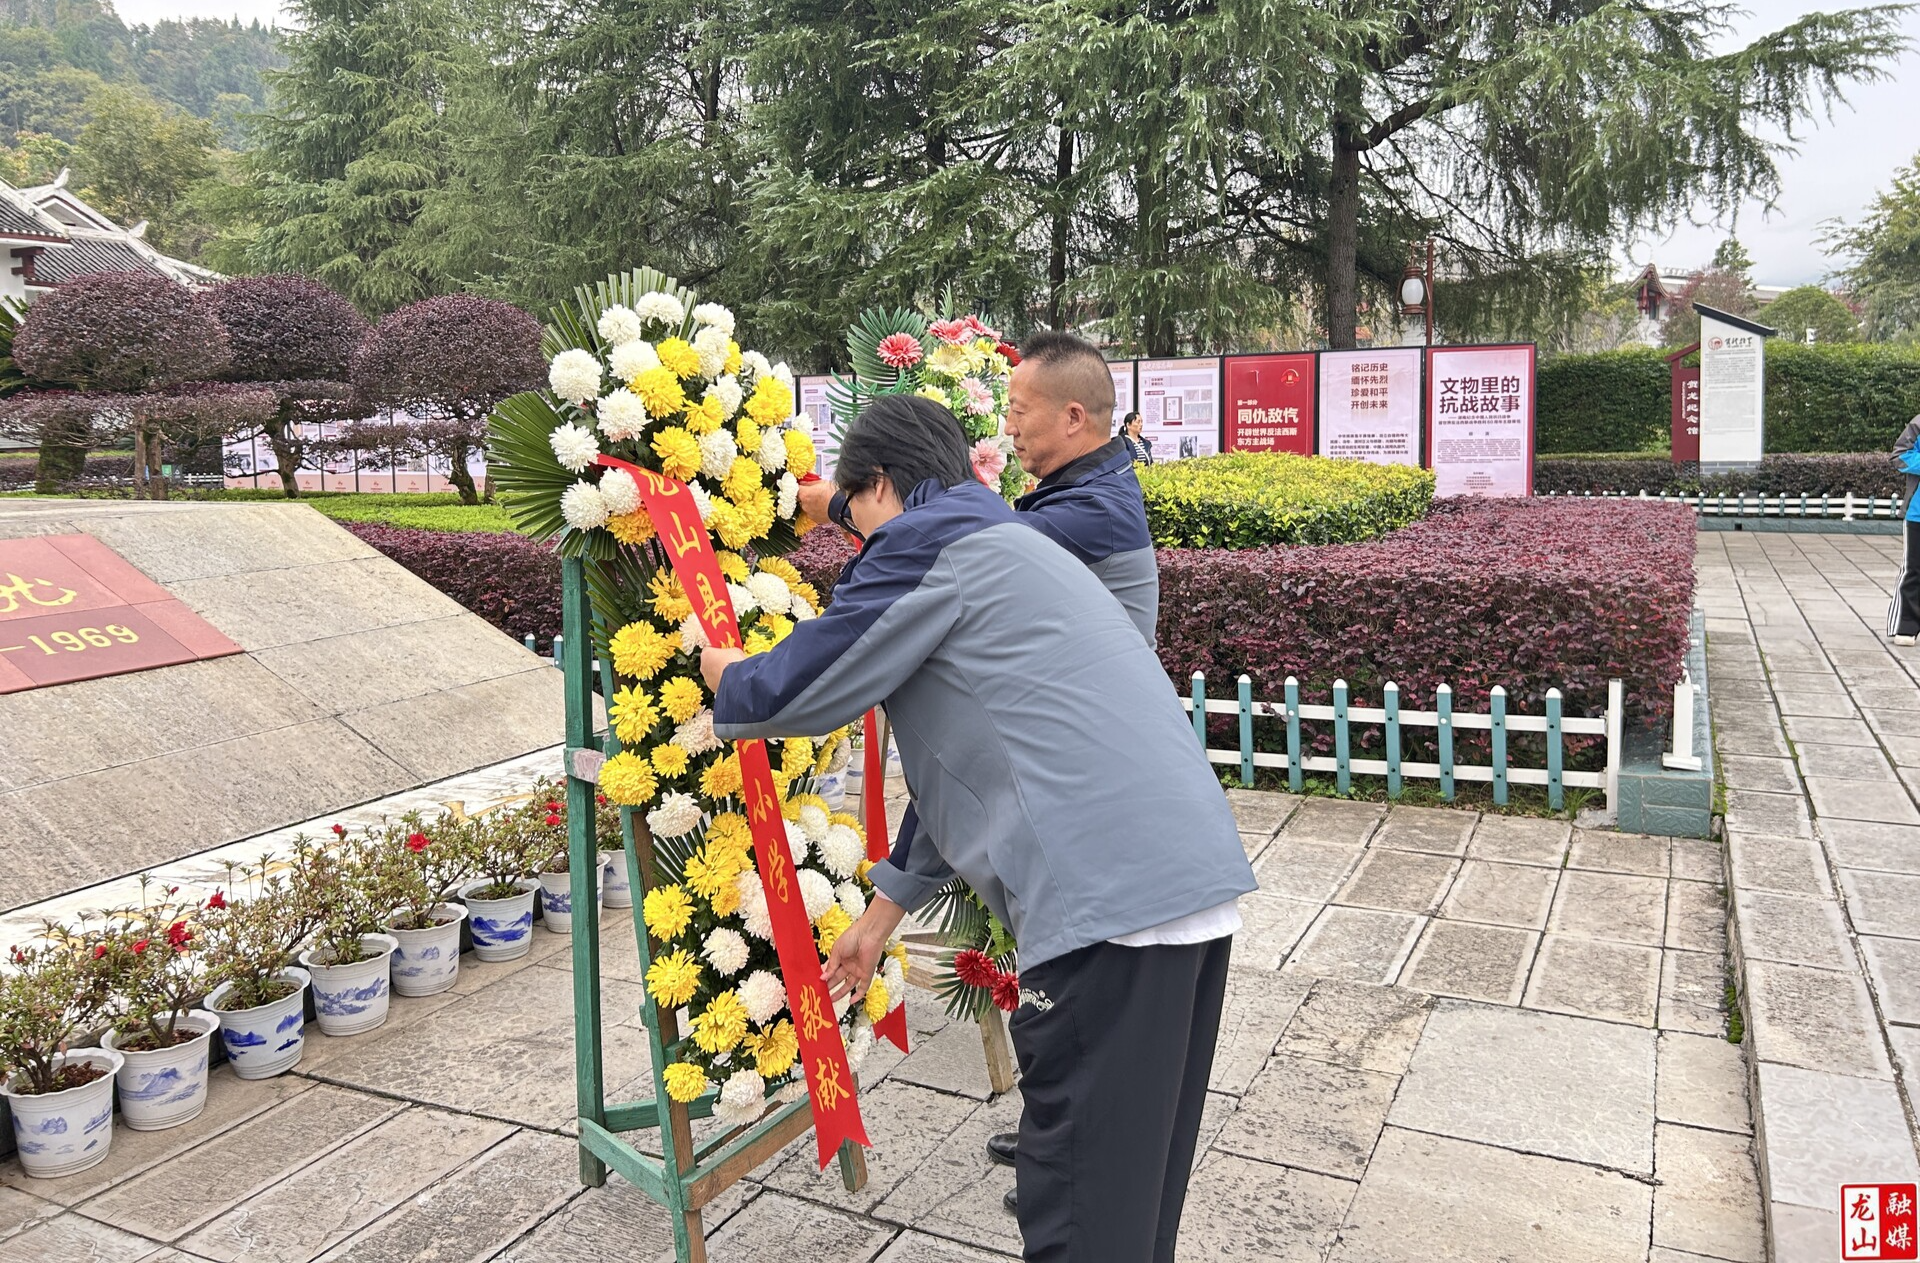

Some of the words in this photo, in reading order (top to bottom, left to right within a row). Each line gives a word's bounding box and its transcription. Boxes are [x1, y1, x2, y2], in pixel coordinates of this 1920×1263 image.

[1351, 363, 1388, 373] 铭记历史
[1351, 375, 1388, 385] 缅怀先烈
[1440, 376, 1520, 395] 文物里的
[1351, 387, 1388, 397] 珍爱和平
[1351, 400, 1388, 410] 开创未来
[1439, 395, 1520, 414] 抗战故事
[1237, 407, 1299, 424] 同仇敌忾
[1237, 427, 1298, 437] 开辟世界反法西斯
[1237, 437, 1275, 446] 东方主战场
